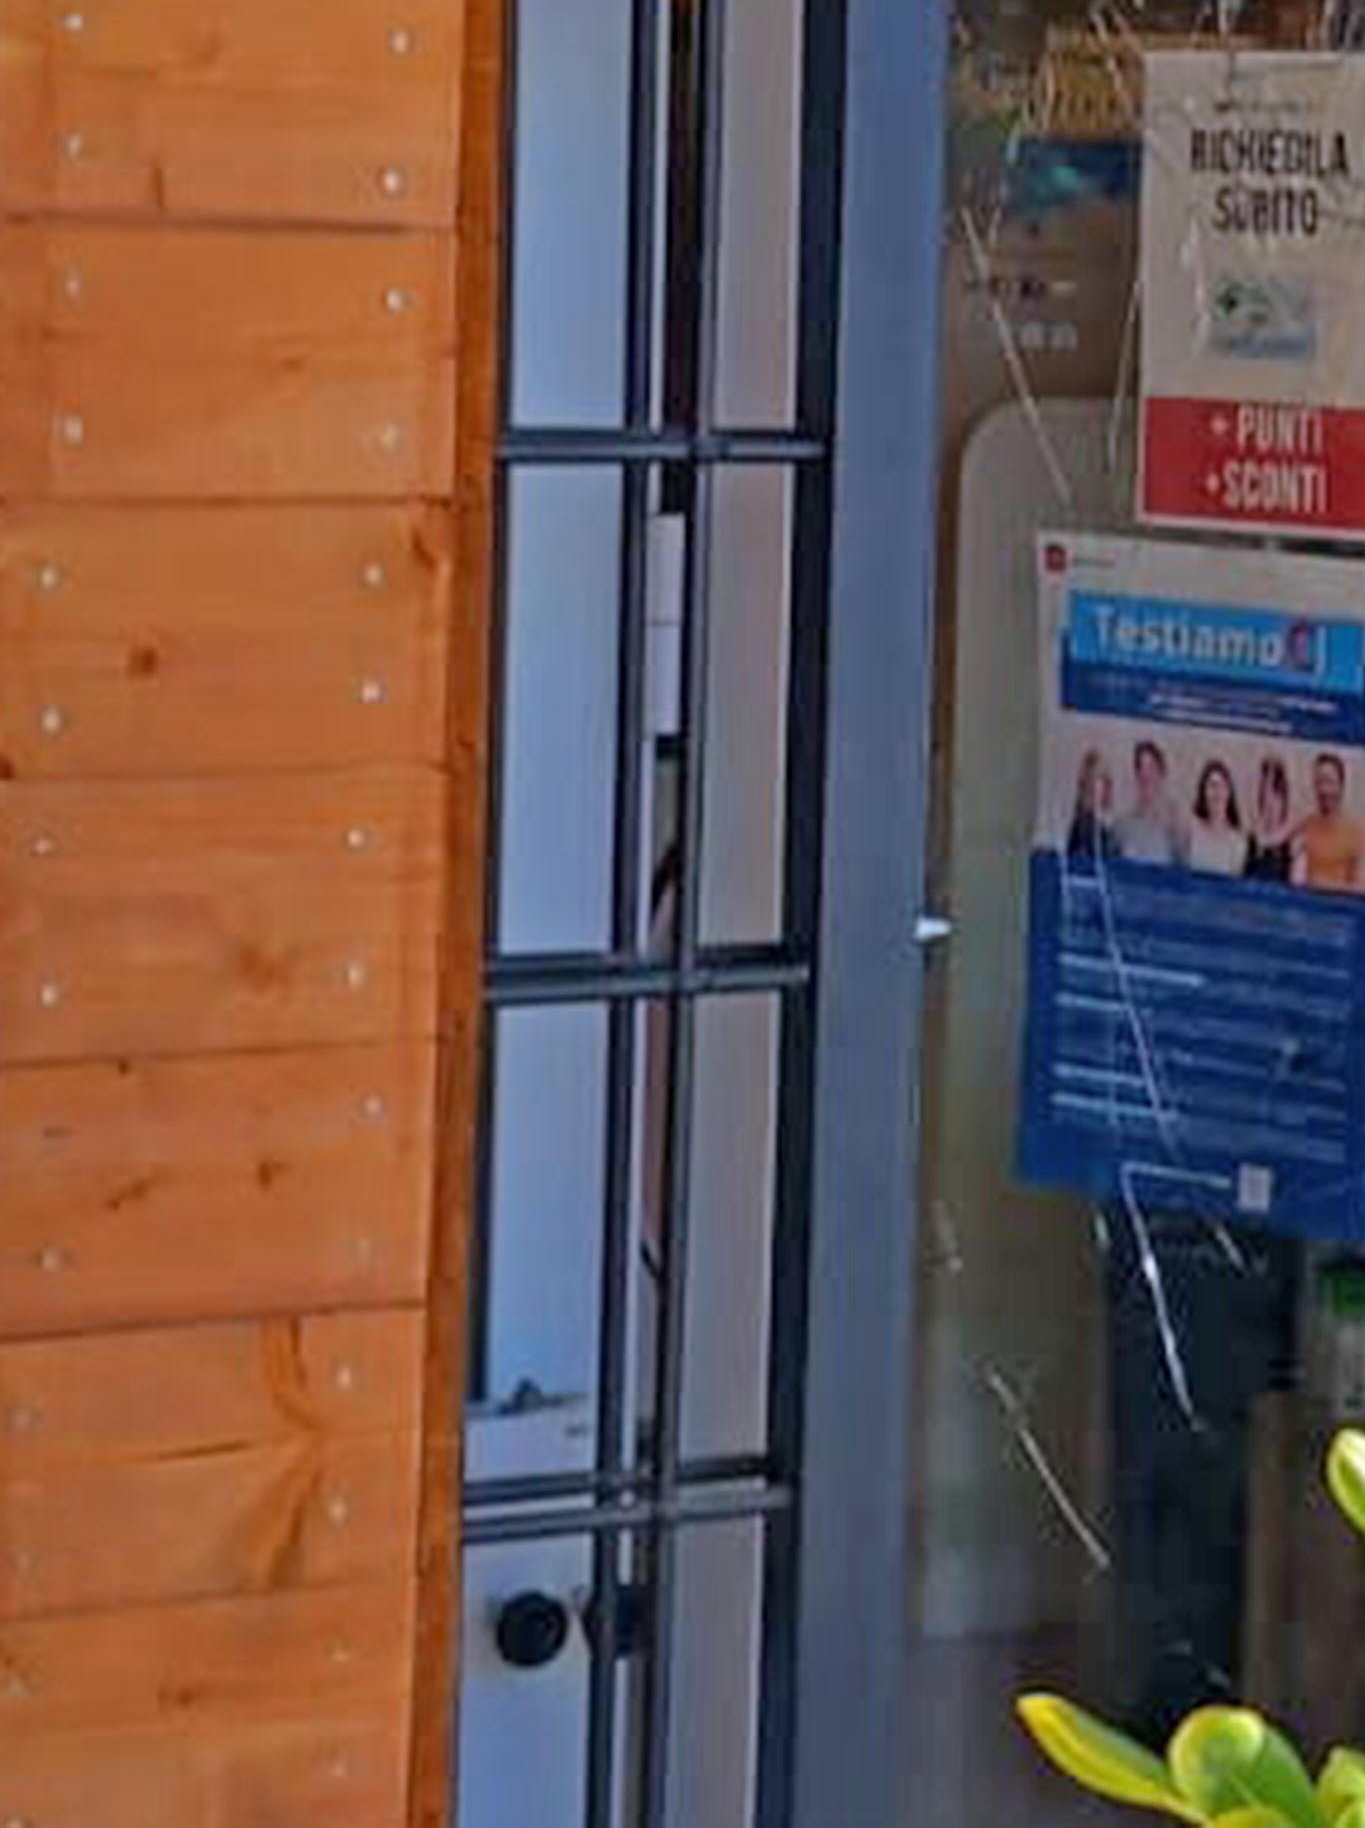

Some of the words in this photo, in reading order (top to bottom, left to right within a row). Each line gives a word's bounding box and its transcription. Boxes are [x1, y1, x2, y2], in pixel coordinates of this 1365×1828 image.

[1190, 128, 1350, 179] RICHIEDILA
[1212, 185, 1318, 236] SUBITO
[1237, 405, 1323, 456] PUNTI
